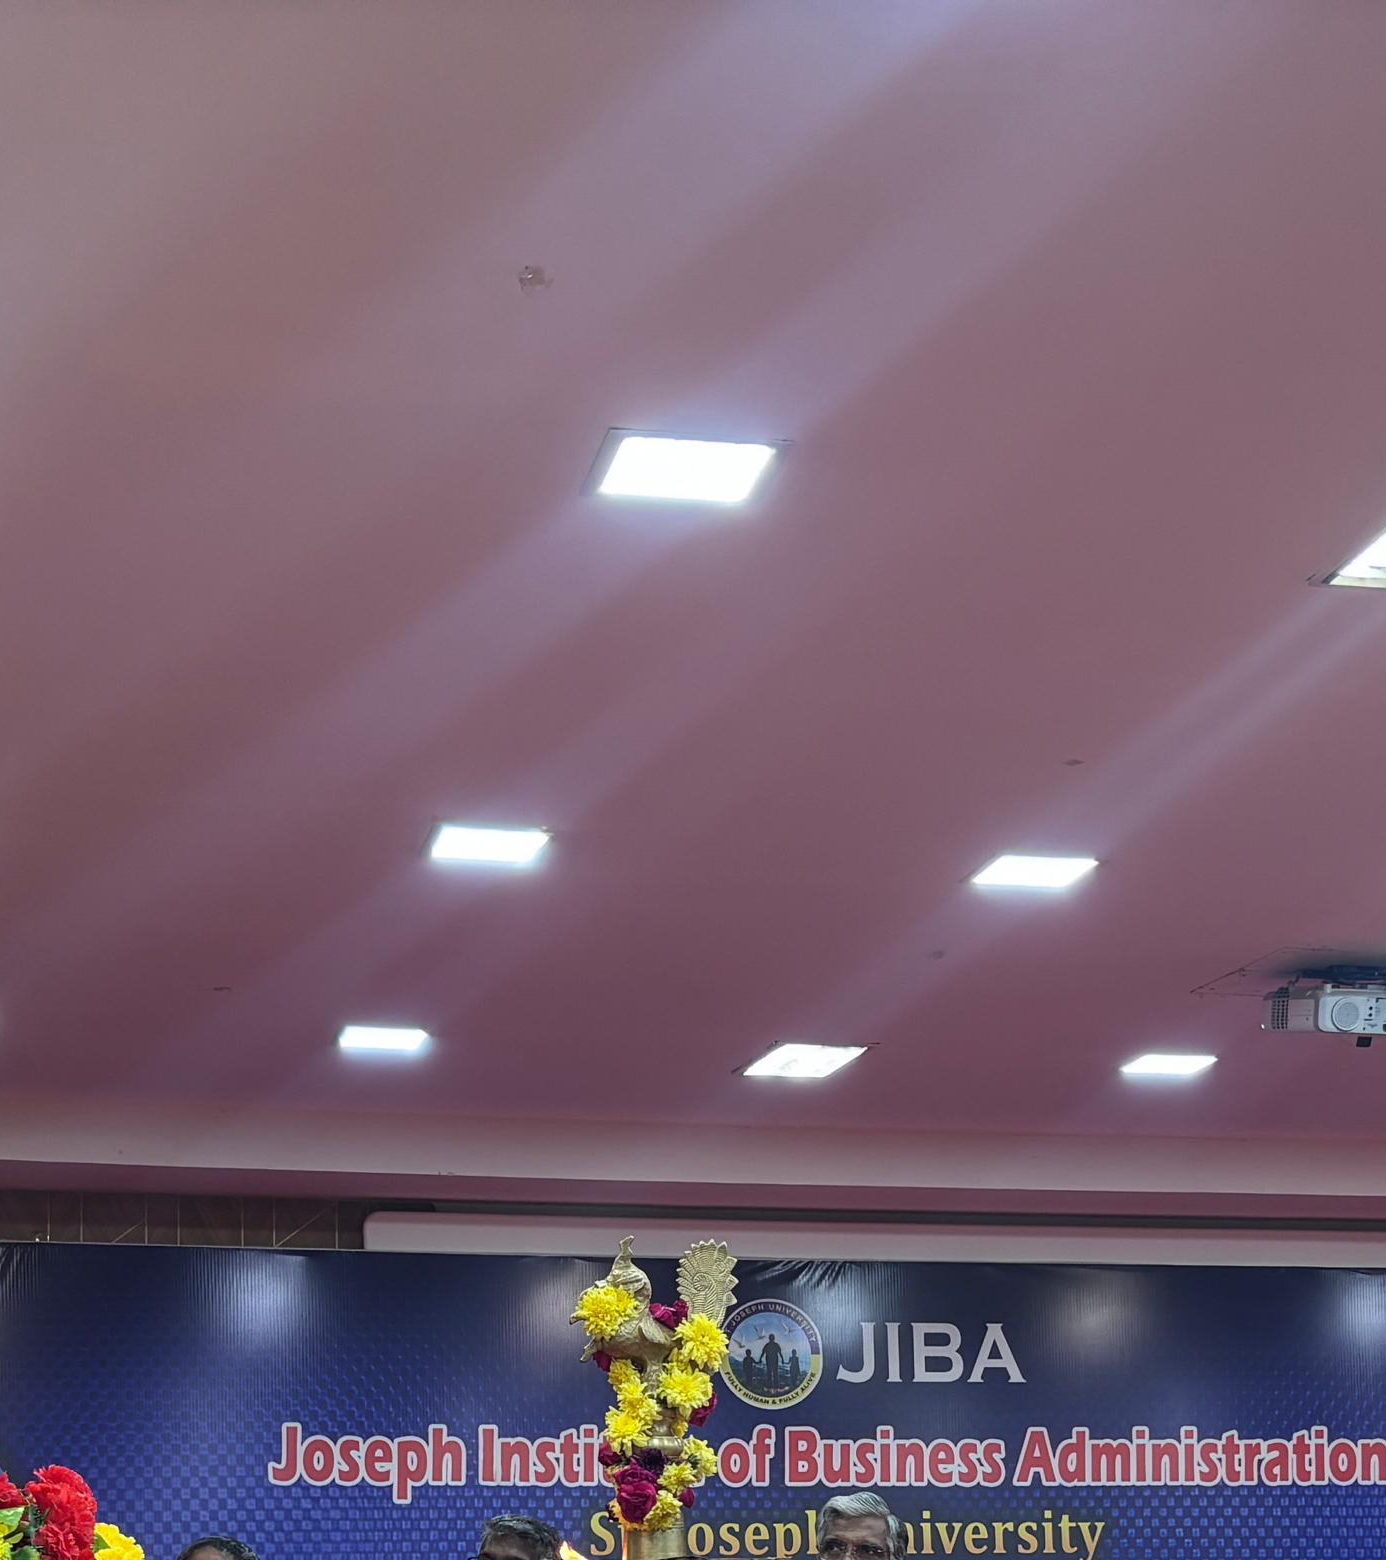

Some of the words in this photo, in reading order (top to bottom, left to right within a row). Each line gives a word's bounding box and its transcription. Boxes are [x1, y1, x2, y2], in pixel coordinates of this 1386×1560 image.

[836, 1322, 1027, 1383] JIBA
[268, 1422, 465, 1503] Joseph
[717, 1424, 775, 1487] of
[783, 1425, 1006, 1487] Business
